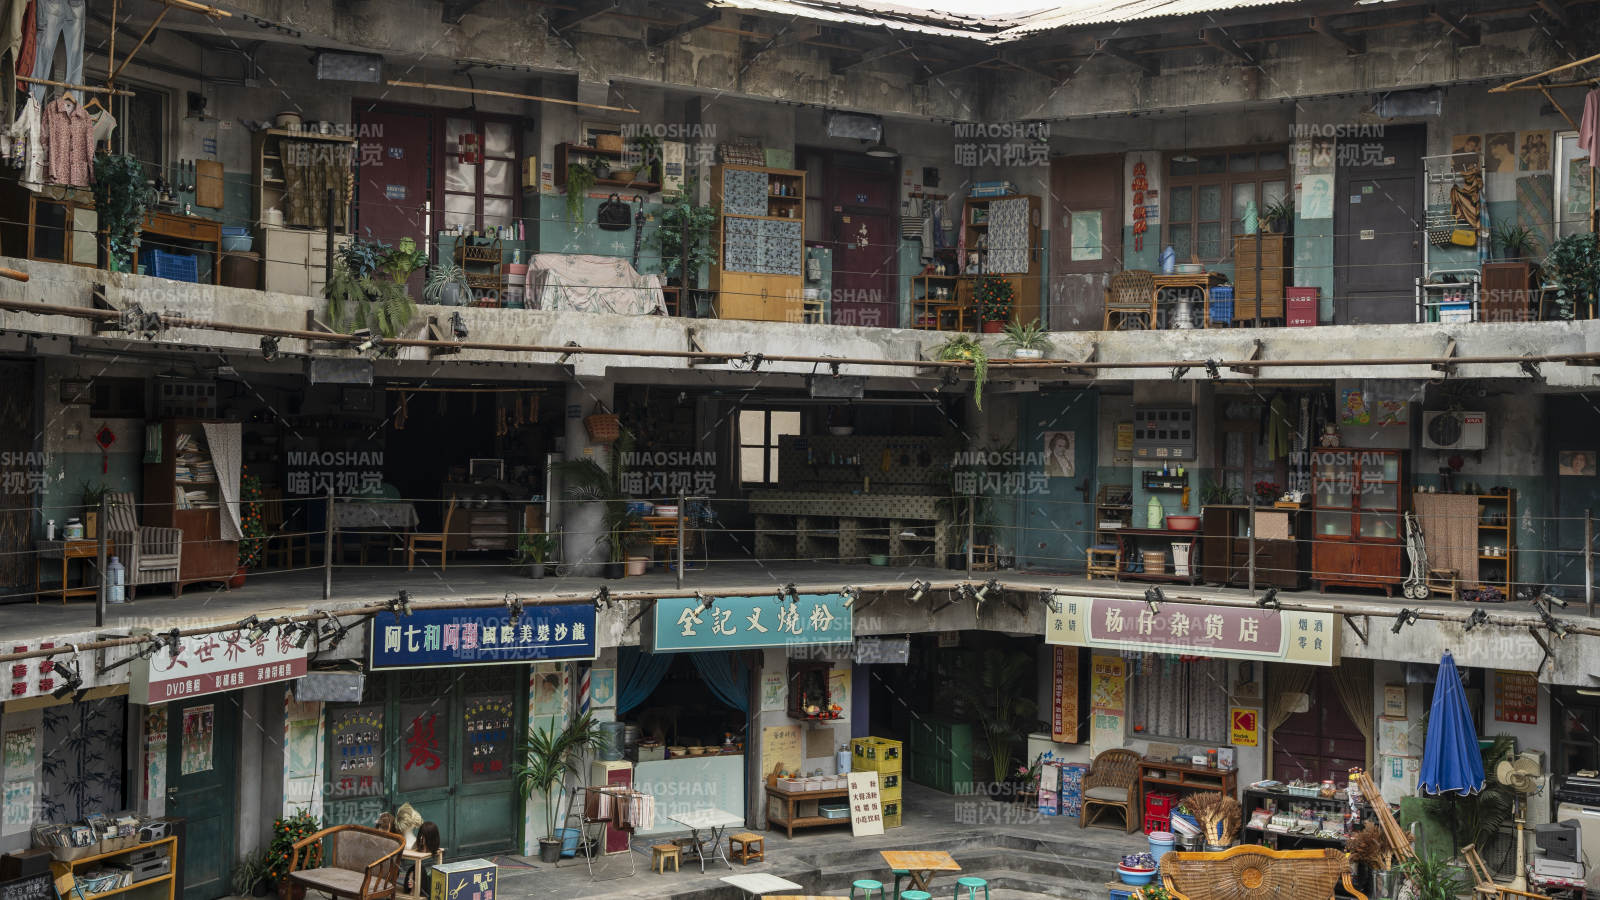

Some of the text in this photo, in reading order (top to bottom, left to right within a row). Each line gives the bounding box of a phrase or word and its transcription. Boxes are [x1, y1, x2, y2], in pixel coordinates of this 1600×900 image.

[1105, 606, 1259, 643] 杨仔杂货店
[1298, 618, 1323, 633] 烟酒
[1298, 636, 1323, 651] 零食
